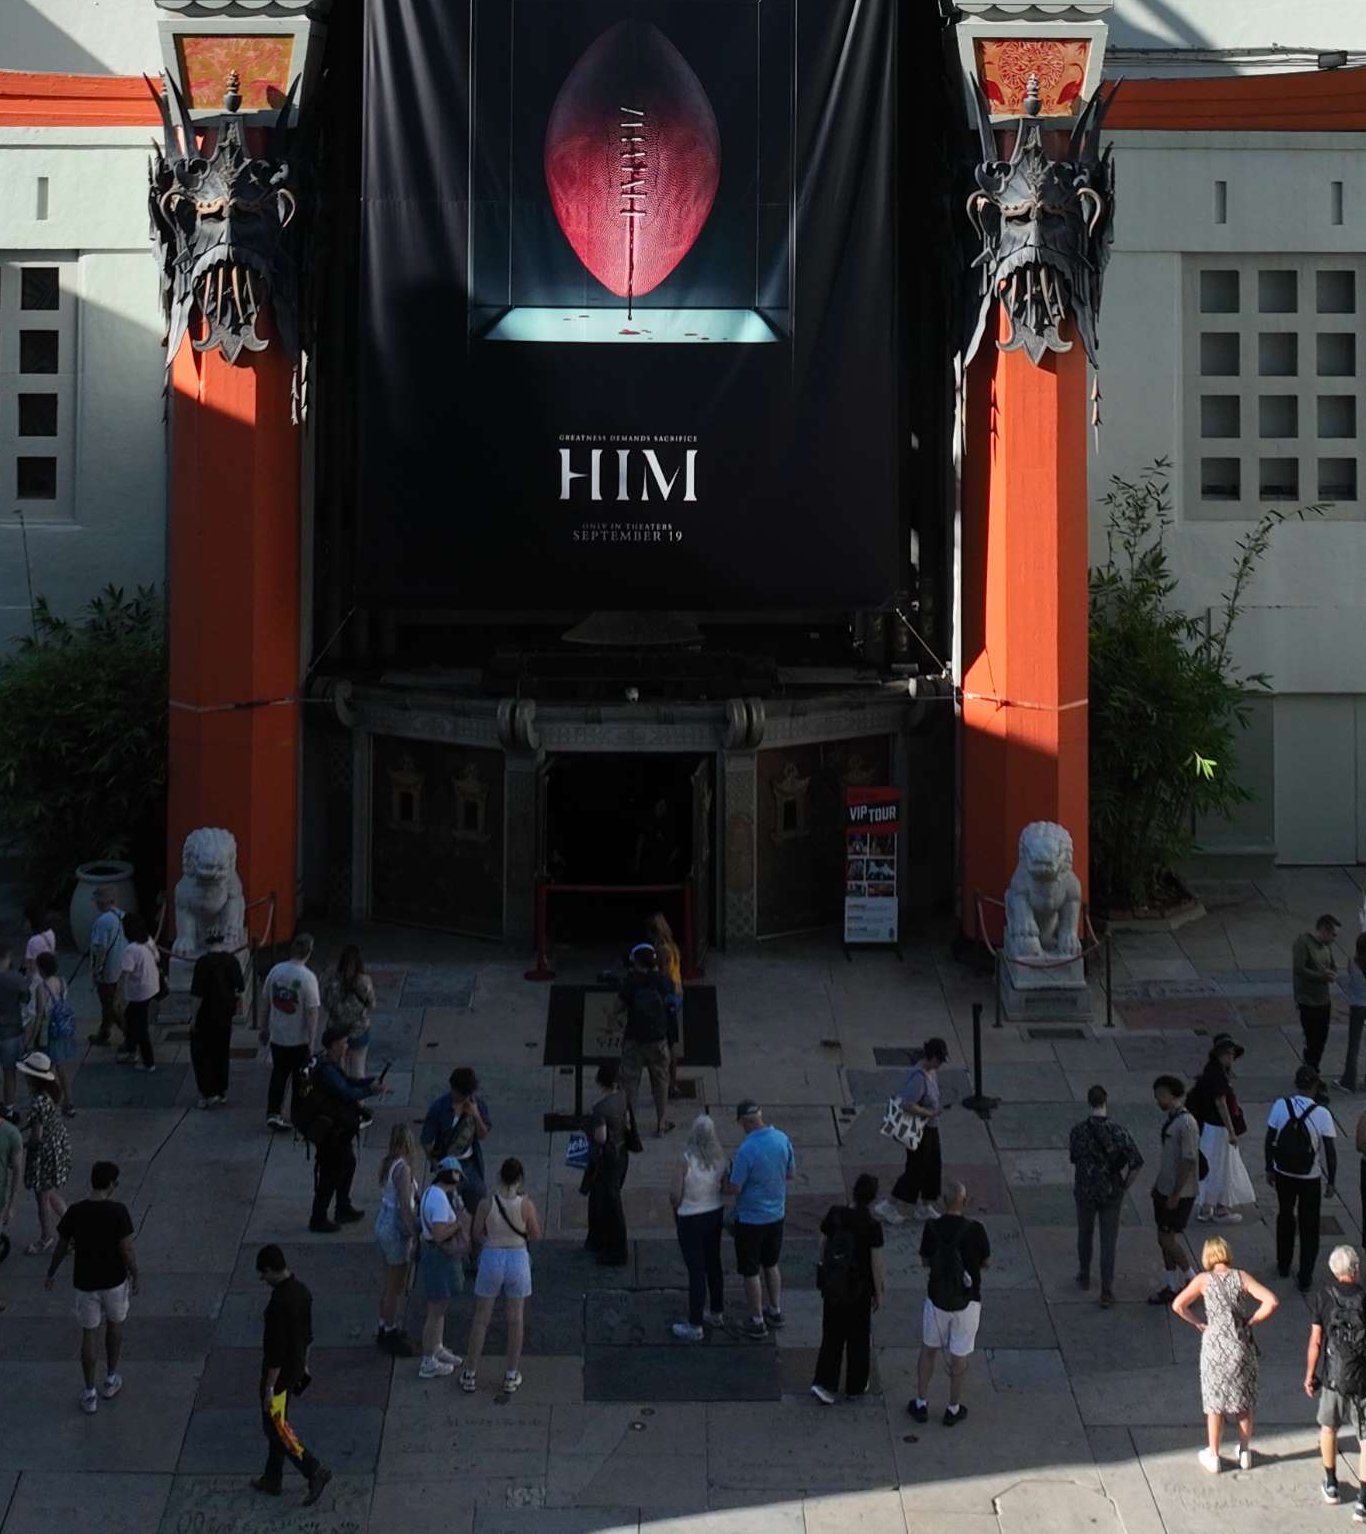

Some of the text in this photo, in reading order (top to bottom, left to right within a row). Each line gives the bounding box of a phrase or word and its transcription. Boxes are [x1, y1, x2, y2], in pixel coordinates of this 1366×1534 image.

[653, 434, 698, 443] SACRIFICE
[557, 448, 698, 501] HIM
[572, 530, 683, 542] SEPTEMBER 19
[849, 804, 897, 824] VIP TOUR
